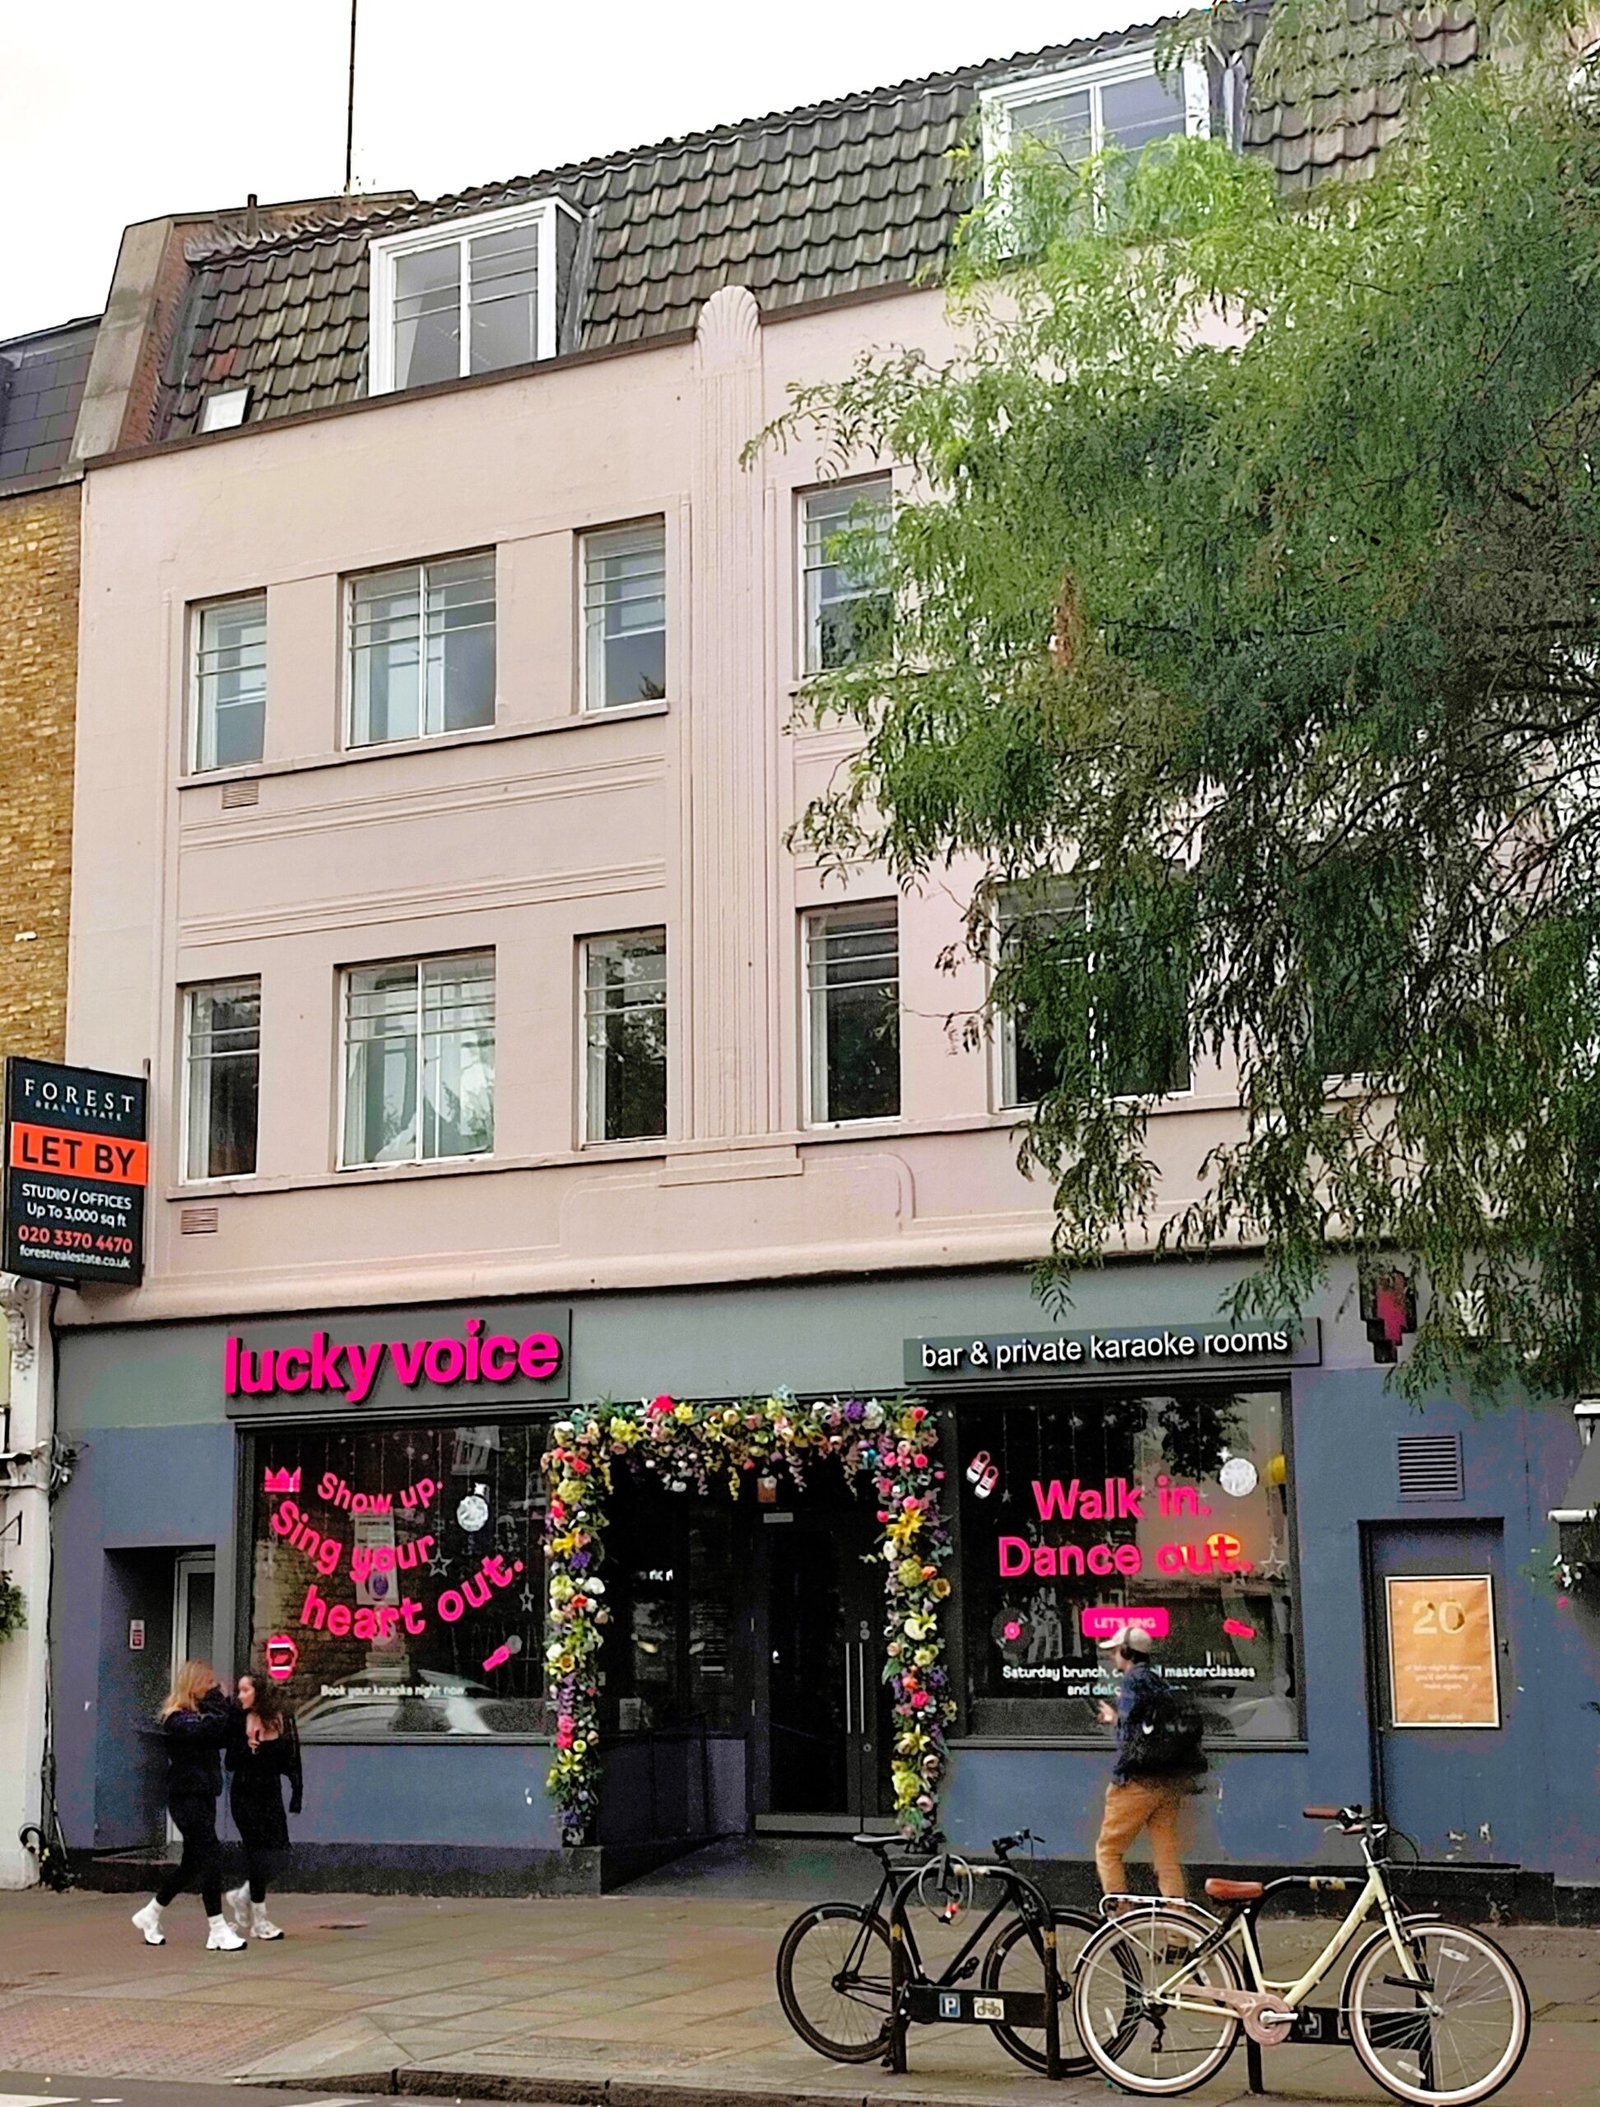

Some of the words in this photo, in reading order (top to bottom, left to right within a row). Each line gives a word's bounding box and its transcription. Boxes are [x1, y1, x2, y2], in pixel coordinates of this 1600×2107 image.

[24, 1078, 135, 1113] FOREST
[35, 1100, 67, 1114] REAL
[75, 1107, 122, 1122] ESTATE
[22, 1132, 82, 1169] LET
[95, 1143, 136, 1177] BY
[22, 1183, 70, 1202] STUDIO
[80, 1191, 132, 1210] OFFICES
[26, 1202, 46, 1219] Up
[47, 1204, 63, 1218] To
[64, 1206, 99, 1223] 3,000
[100, 1213, 115, 1228] sq
[117, 1213, 127, 1227] ft
[18, 1224, 50, 1244] 020
[53, 1229, 92, 1248] 3370
[95, 1234, 133, 1254] 4470
[19, 1244, 131, 1269] forestrealestate.co.uk
[225, 1331, 383, 1403] lucky
[390, 1319, 559, 1386] voice
[922, 1344, 963, 1368] bar
[970, 1341, 989, 1366] &
[997, 1337, 1082, 1370] private
[1091, 1332, 1196, 1359] karaoke
[1204, 1330, 1289, 1354] rooms
[317, 1472, 392, 1514] Show
[400, 1478, 444, 1509] up.
[1031, 1478, 1146, 1521] Walk
[1157, 1475, 1213, 1517] in.
[271, 1500, 343, 1576] Sing
[350, 1535, 436, 1583] your
[998, 1536, 1143, 1578] Dance
[1155, 1535, 1254, 1576] out.
[300, 1584, 427, 1640] heart
[438, 1554, 525, 1622] out.
[1411, 1598, 1466, 1636] 20
[1002, 1665, 1060, 1681] Saturday
[1062, 1665, 1109, 1680] brunch,
[1165, 1666, 1255, 1678] masterclasses
[1067, 1684, 1090, 1697] and
[320, 1684, 346, 1697] Book
[347, 1686, 371, 1699] your
[372, 1684, 413, 1697] karaoke
[415, 1684, 440, 1699] night
[944, 1997, 957, 2015] P
